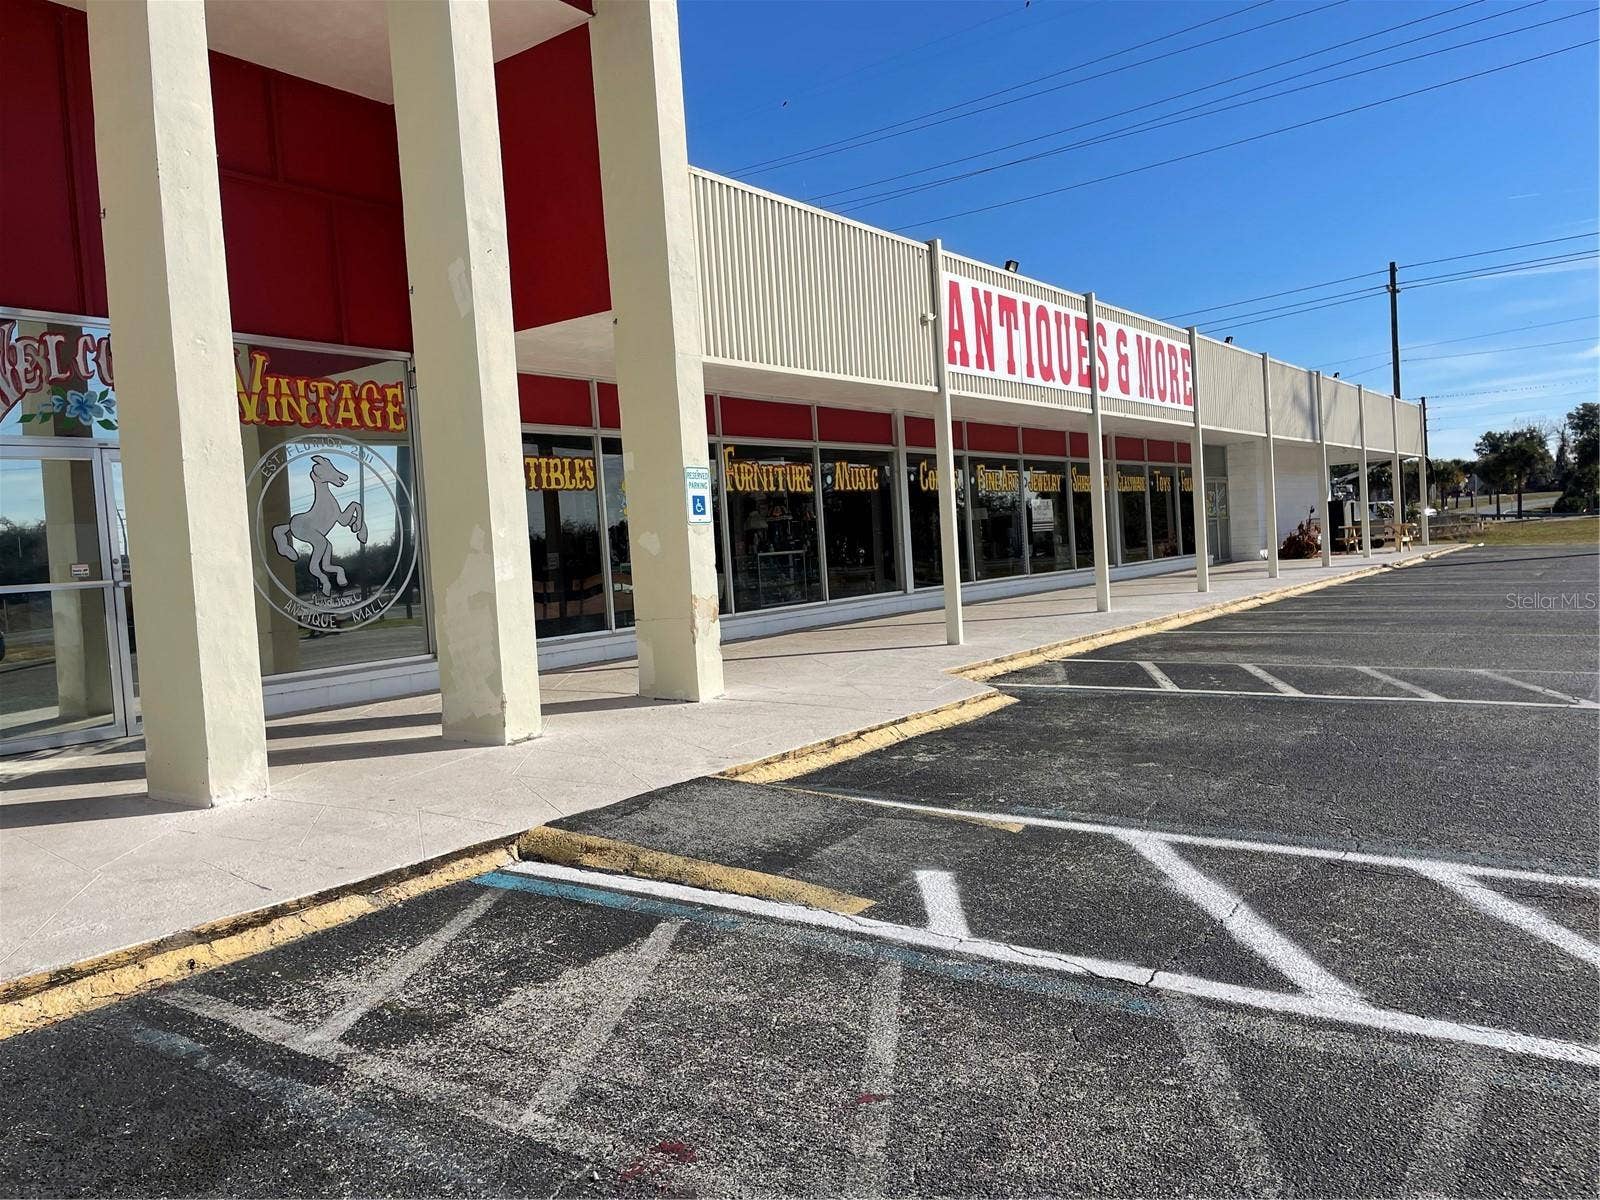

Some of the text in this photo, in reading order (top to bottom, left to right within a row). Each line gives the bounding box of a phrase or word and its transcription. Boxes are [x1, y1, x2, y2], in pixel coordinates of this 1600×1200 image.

[948, 280, 1193, 406] ANTIQUES & MORE
[235, 350, 407, 432] VINTAGE
[523, 456, 596, 491] TIBLES
[687, 471, 709, 480] RESERVED
[688, 481, 708, 489] PARKING
[724, 446, 879, 492] FURNITURE MUSIC
[284, 598, 388, 628] ANTIQUE MALL
